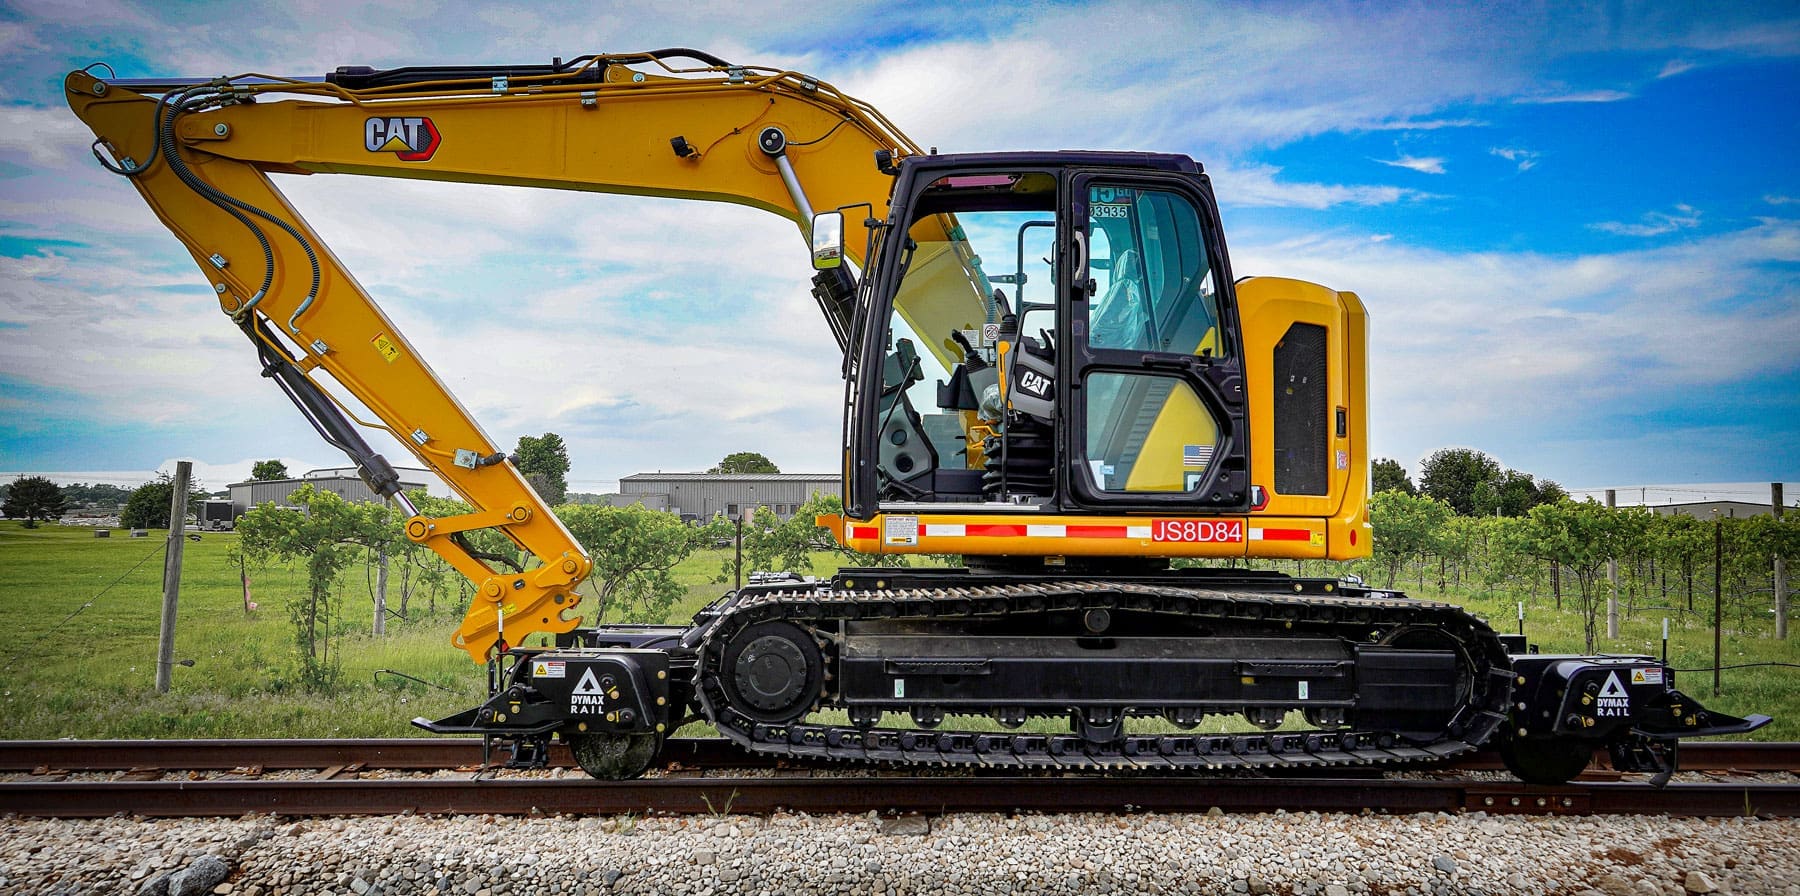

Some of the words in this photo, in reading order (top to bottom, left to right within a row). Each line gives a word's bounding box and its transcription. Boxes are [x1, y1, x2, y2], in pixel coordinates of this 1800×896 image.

[366, 117, 422, 151] CAT
[1021, 371, 1051, 396] CAT
[1154, 522, 1241, 541] JS8D84
[571, 695, 604, 705] DYMAX
[1597, 698, 1629, 708] DYMAX
[570, 705, 604, 714] RAIL
[1597, 708, 1630, 716] RAIL
